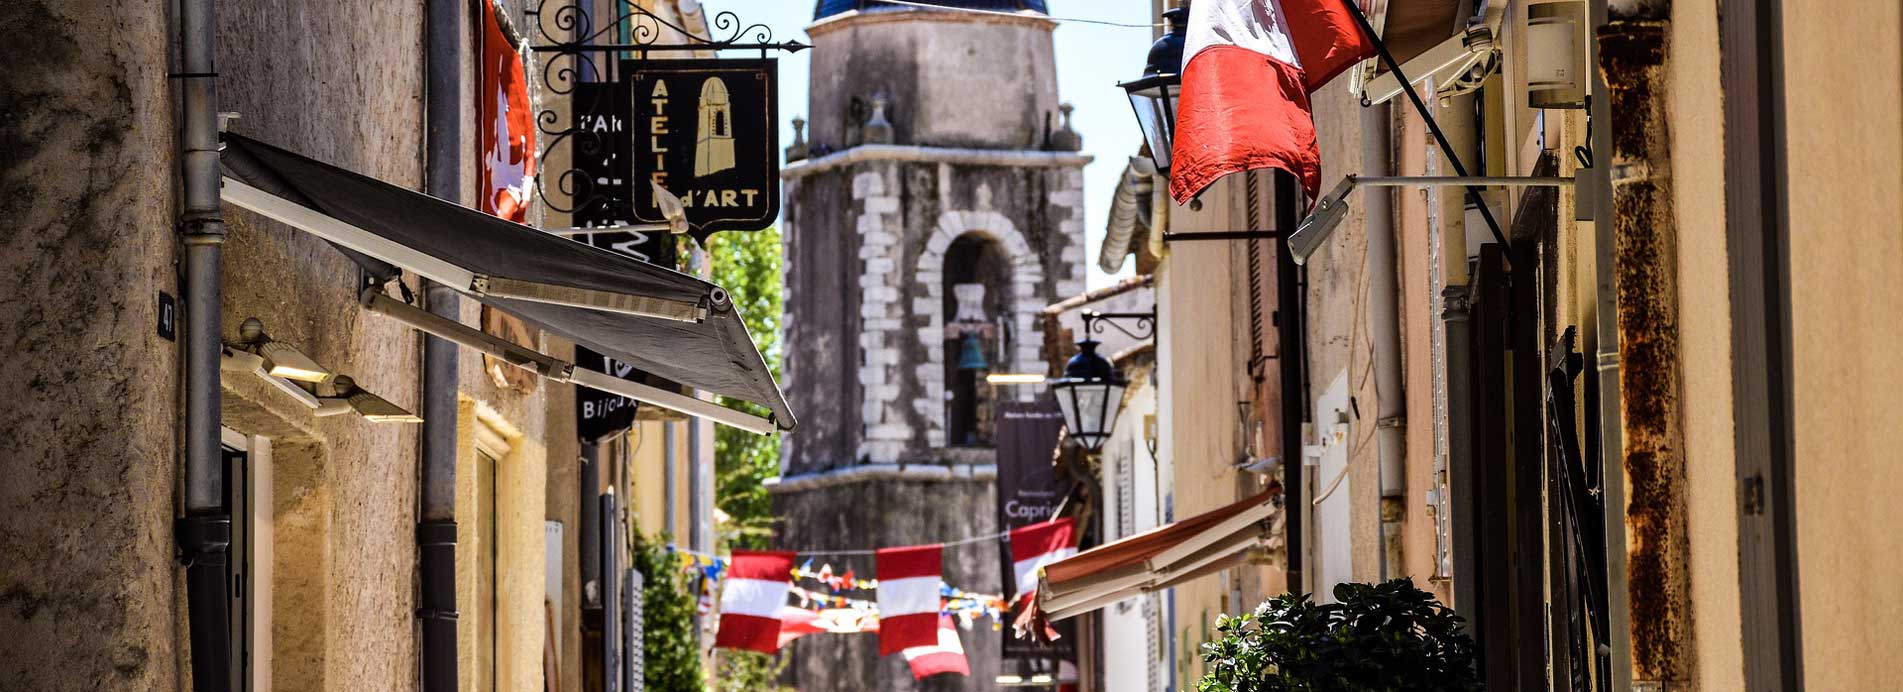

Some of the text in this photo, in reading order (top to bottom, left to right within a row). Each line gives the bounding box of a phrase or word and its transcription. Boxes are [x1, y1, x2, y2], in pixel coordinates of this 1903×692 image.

[651, 79, 669, 208] ATELIE
[679, 189, 759, 208] d'ART
[163, 303, 173, 332] 47
[583, 394, 637, 419] Bijoux
